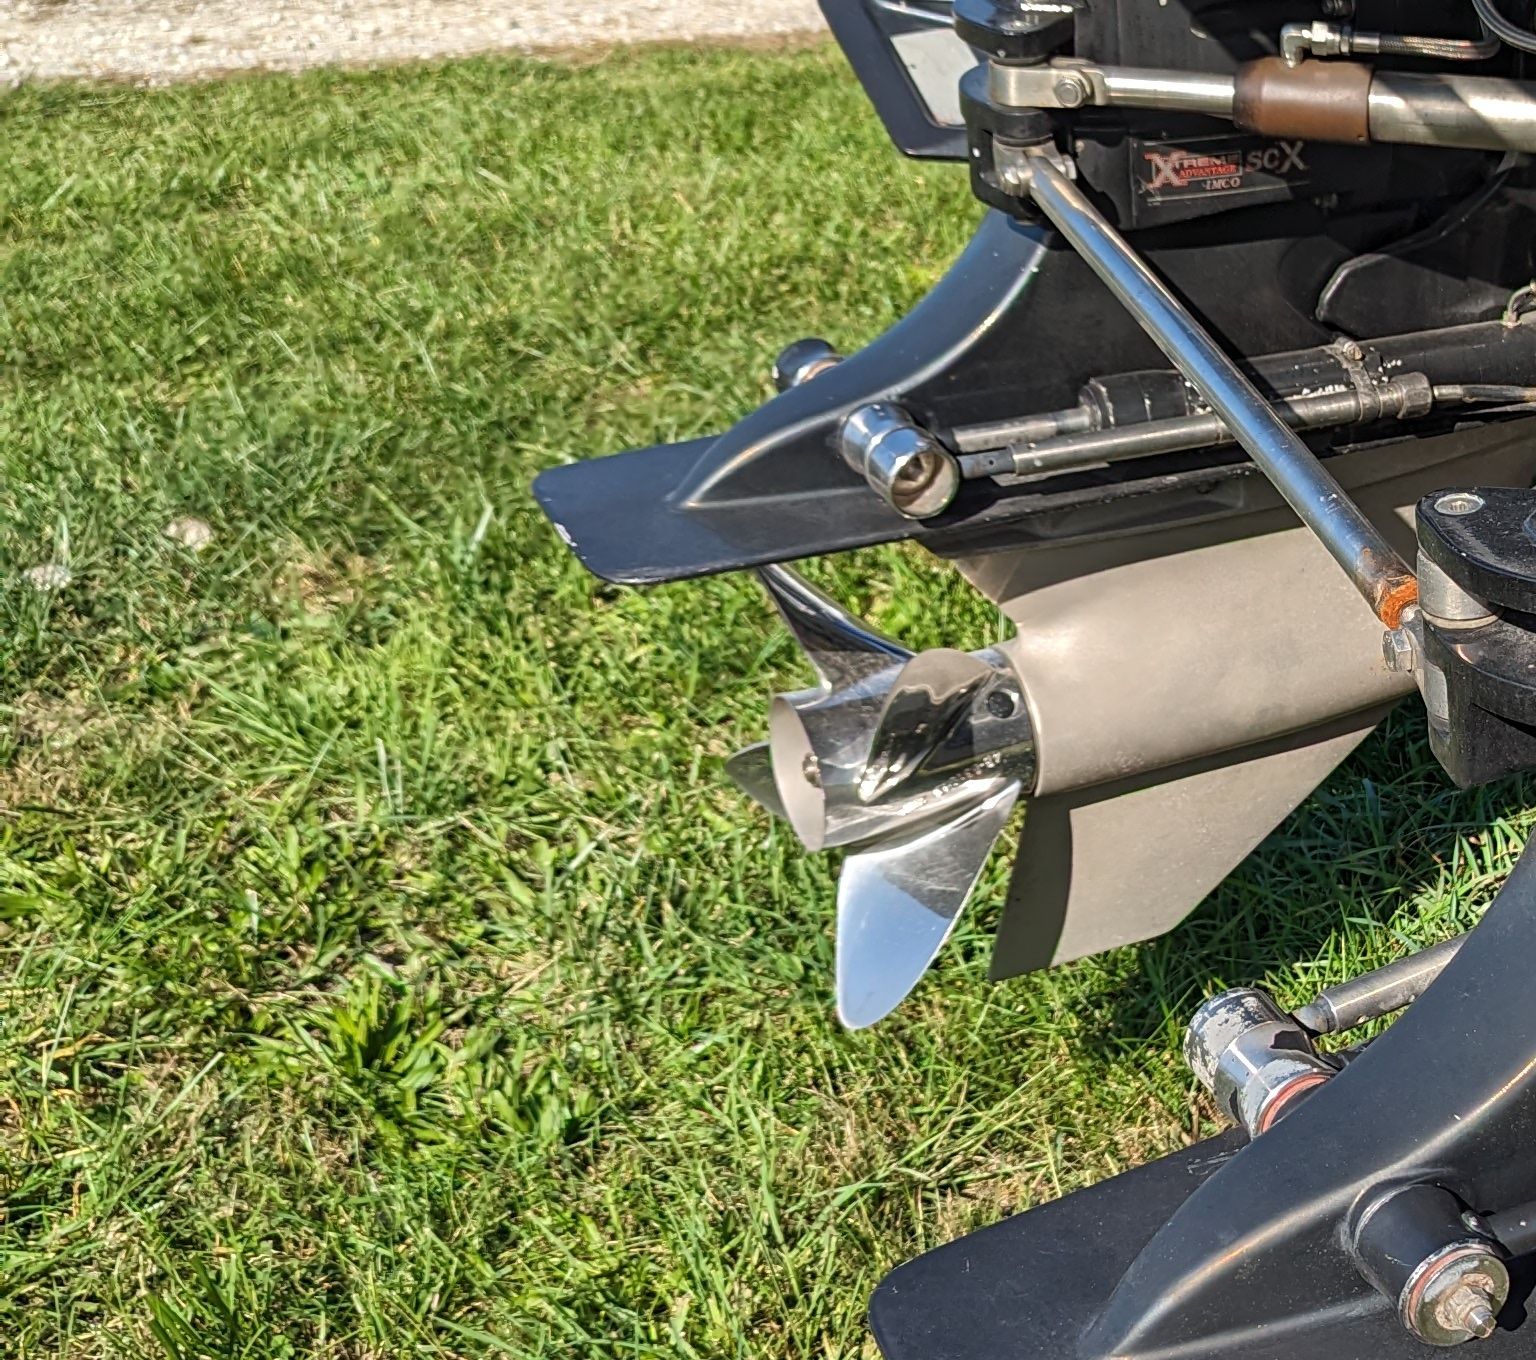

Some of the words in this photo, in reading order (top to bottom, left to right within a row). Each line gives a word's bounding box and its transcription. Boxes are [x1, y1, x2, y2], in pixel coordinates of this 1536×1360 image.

[1246, 140, 1309, 174] SCX
[1179, 164, 1238, 180] ADVANTAGE
[1204, 177, 1241, 190] IMCO
